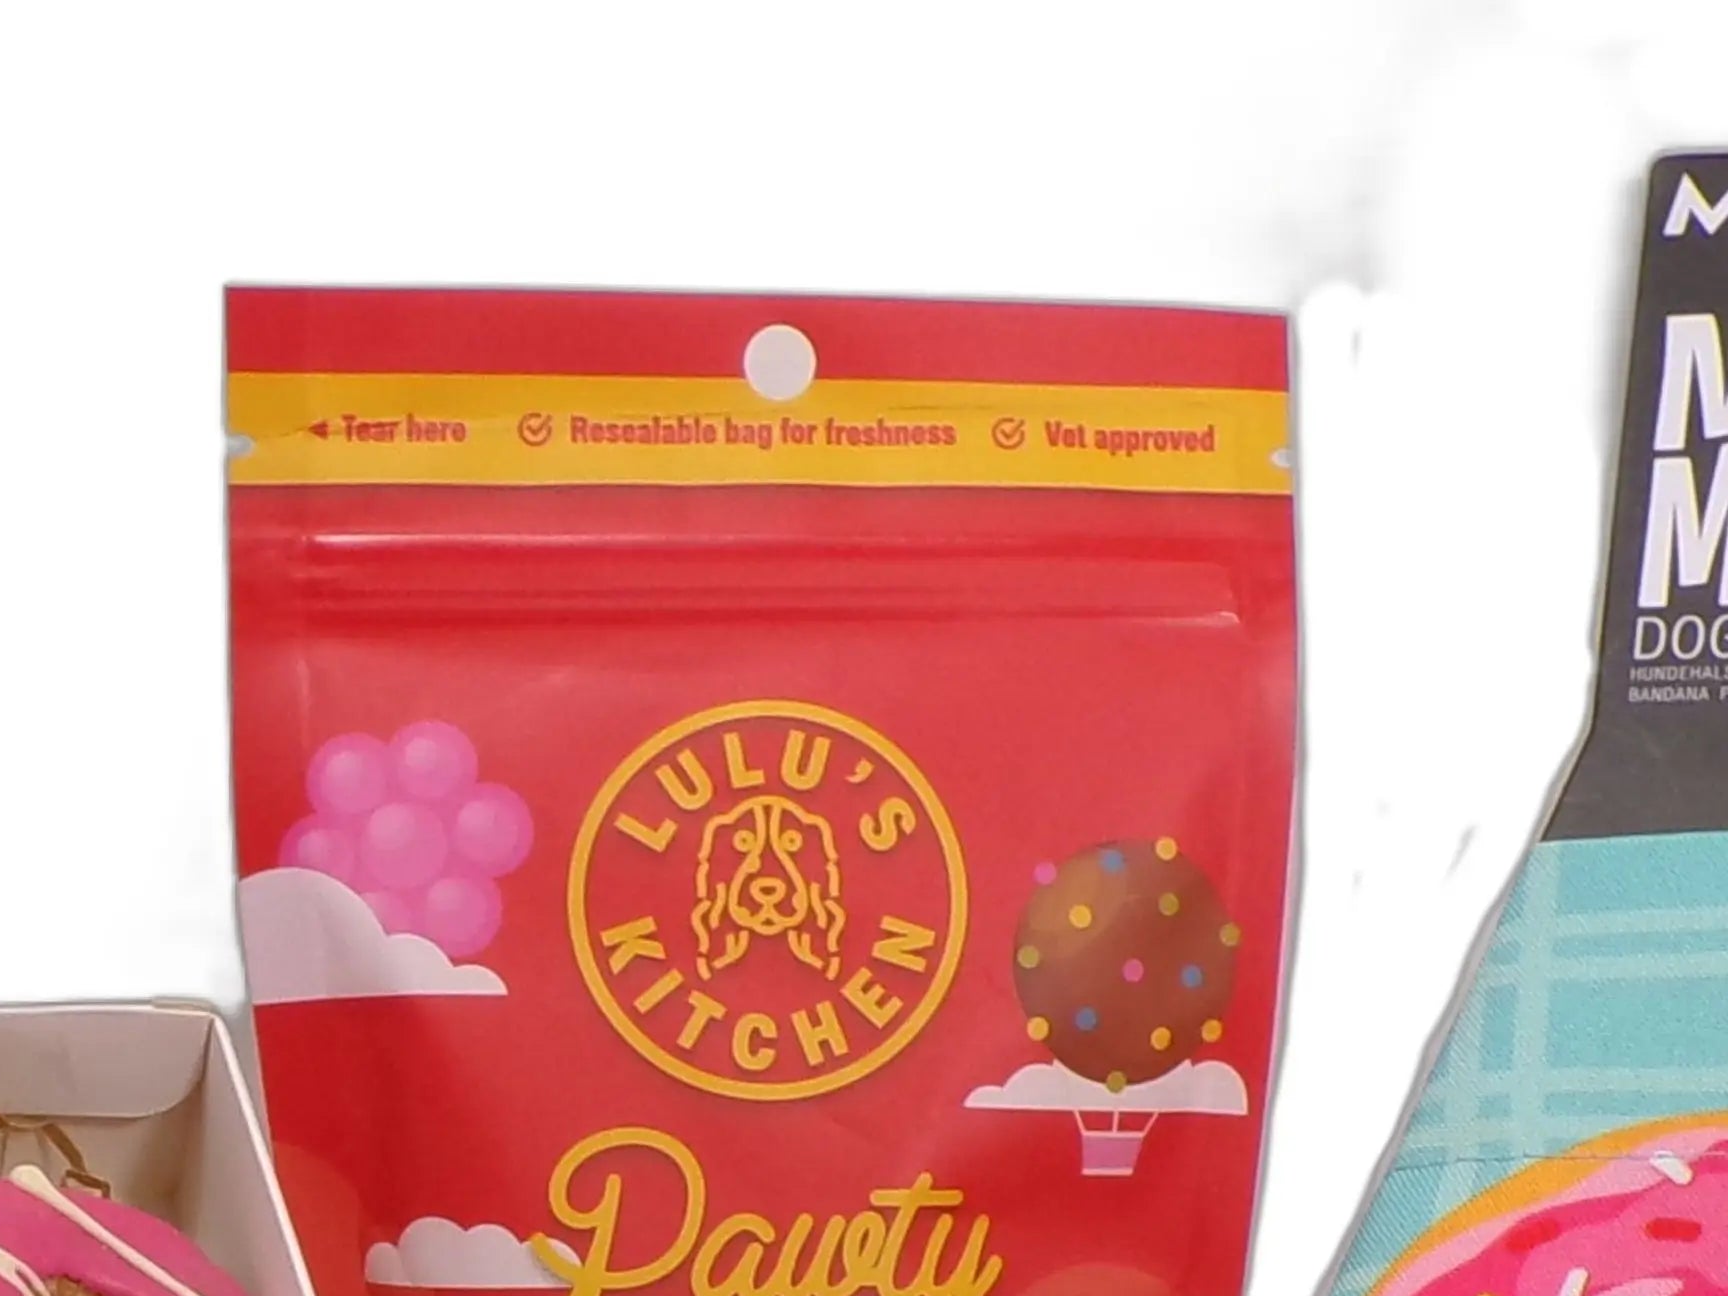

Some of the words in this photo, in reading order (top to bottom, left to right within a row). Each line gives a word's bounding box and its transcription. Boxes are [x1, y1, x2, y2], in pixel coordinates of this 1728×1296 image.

[342, 413, 399, 442] Tear
[405, 412, 467, 443] here
[570, 415, 717, 445] Resealable
[724, 416, 772, 450] bag
[781, 416, 818, 445] for
[825, 417, 958, 447] freshness
[1044, 421, 1085, 449] Vet
[1094, 423, 1217, 457] approved
[1628, 685, 1710, 702] BANDANA
[599, 914, 936, 1072] KITCHEN
